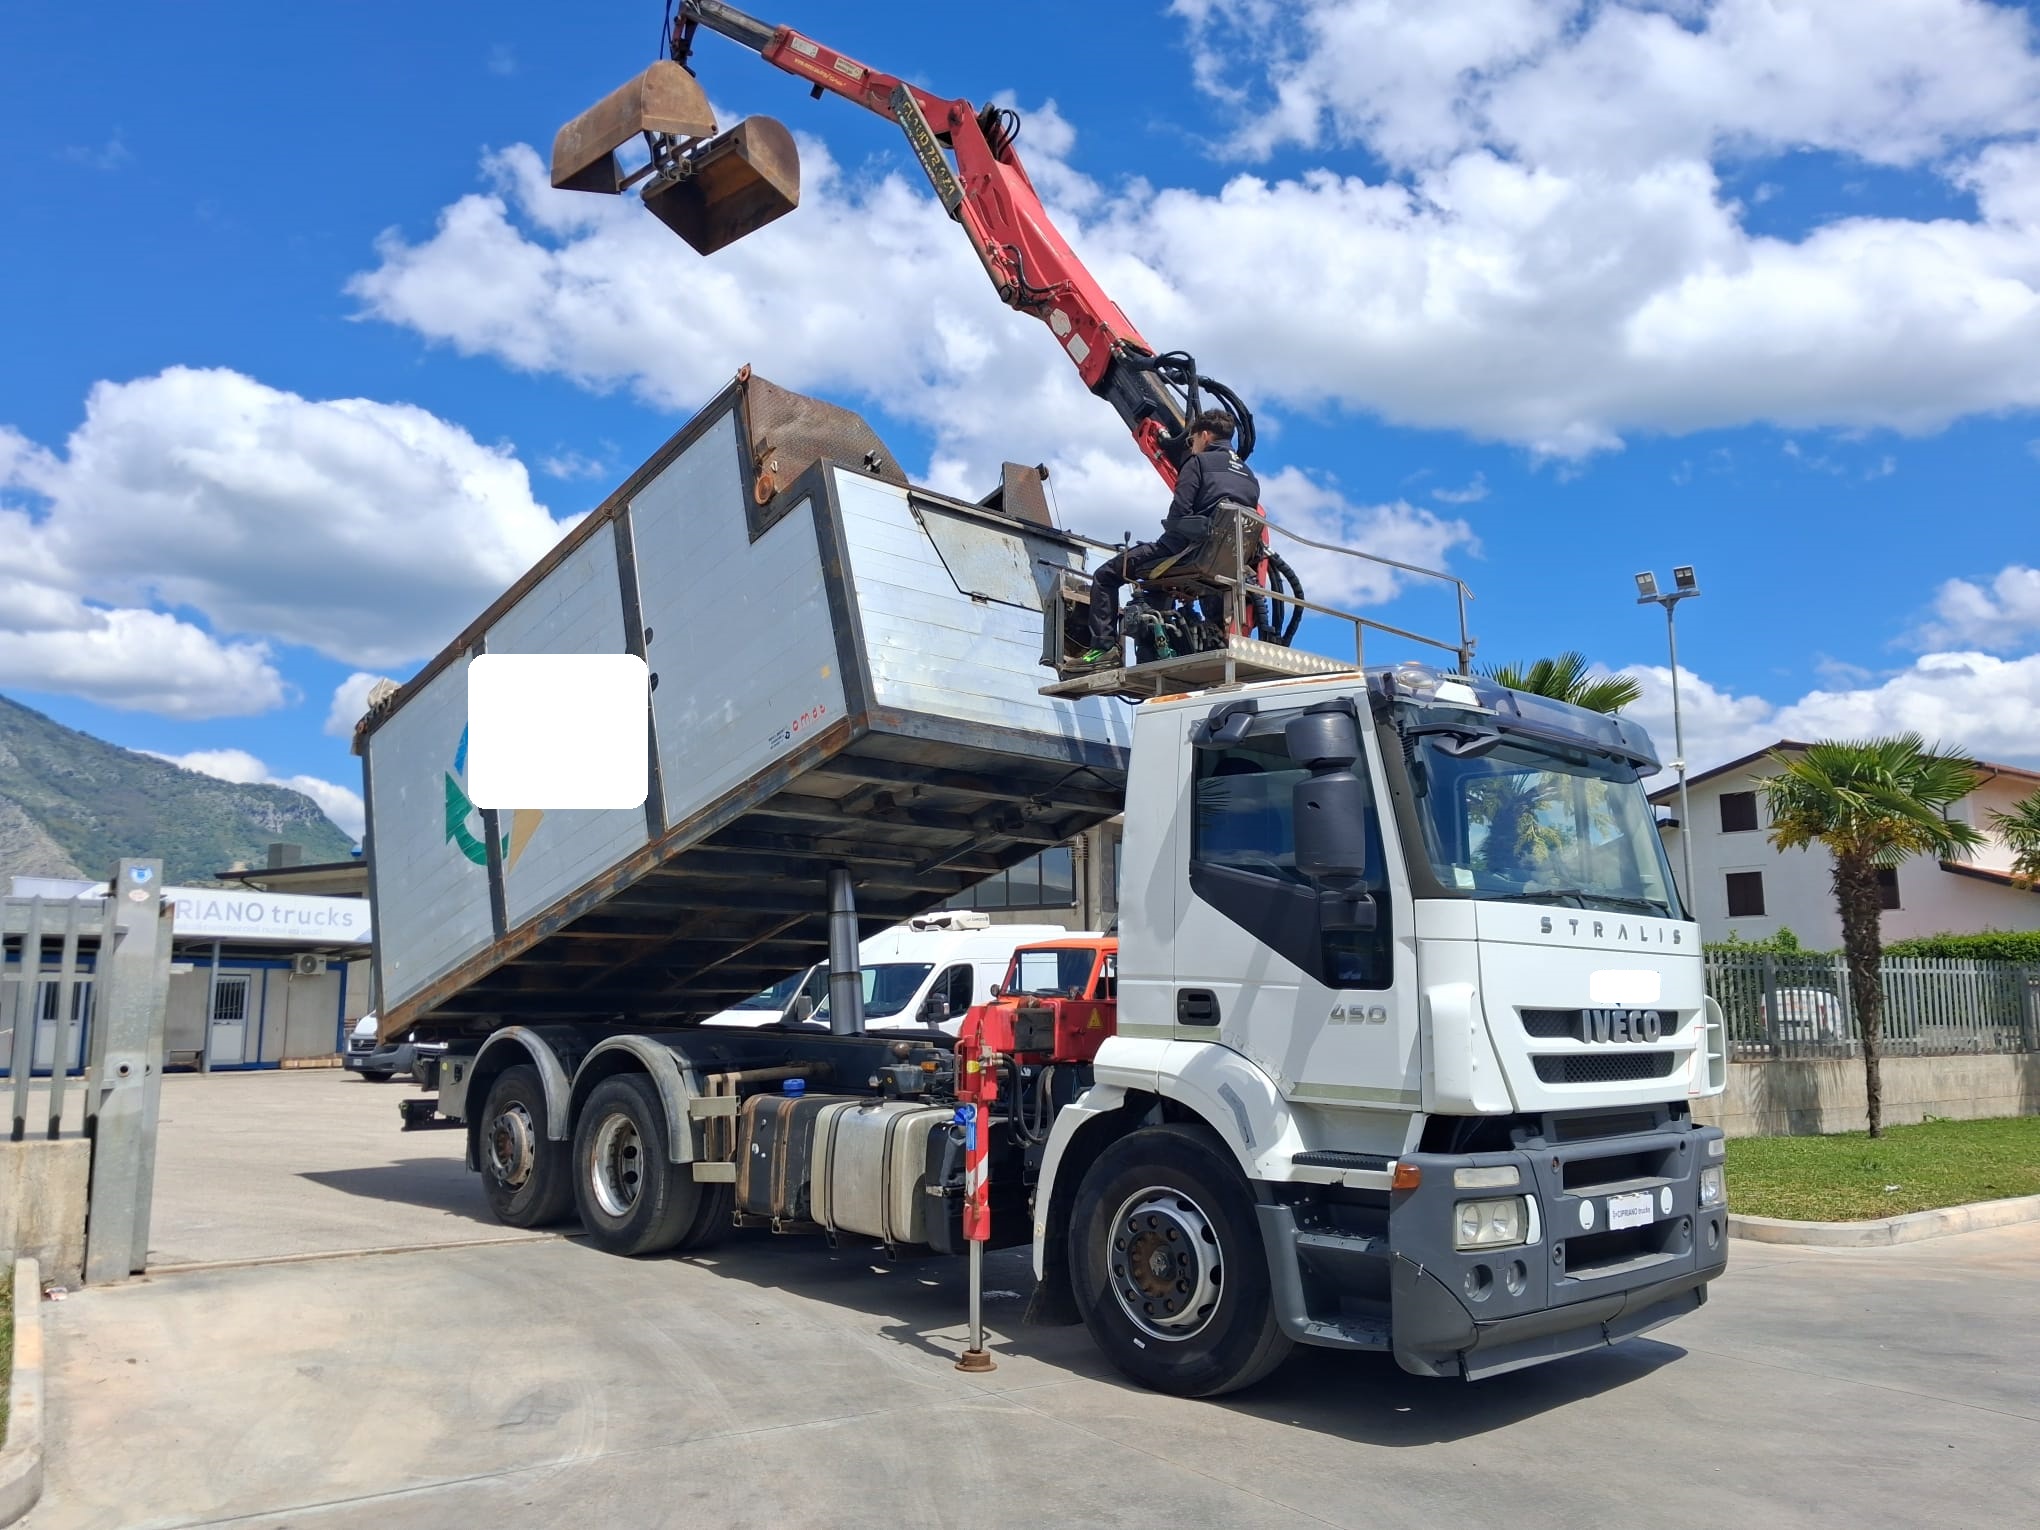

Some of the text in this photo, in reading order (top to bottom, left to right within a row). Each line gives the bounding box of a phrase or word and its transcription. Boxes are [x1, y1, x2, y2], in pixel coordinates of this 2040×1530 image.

[271, 905, 353, 927] trucks
[1540, 916, 1682, 945] STRALIS
[1328, 1003, 1387, 1025] 450
[1581, 1008, 1662, 1044] IVECO
